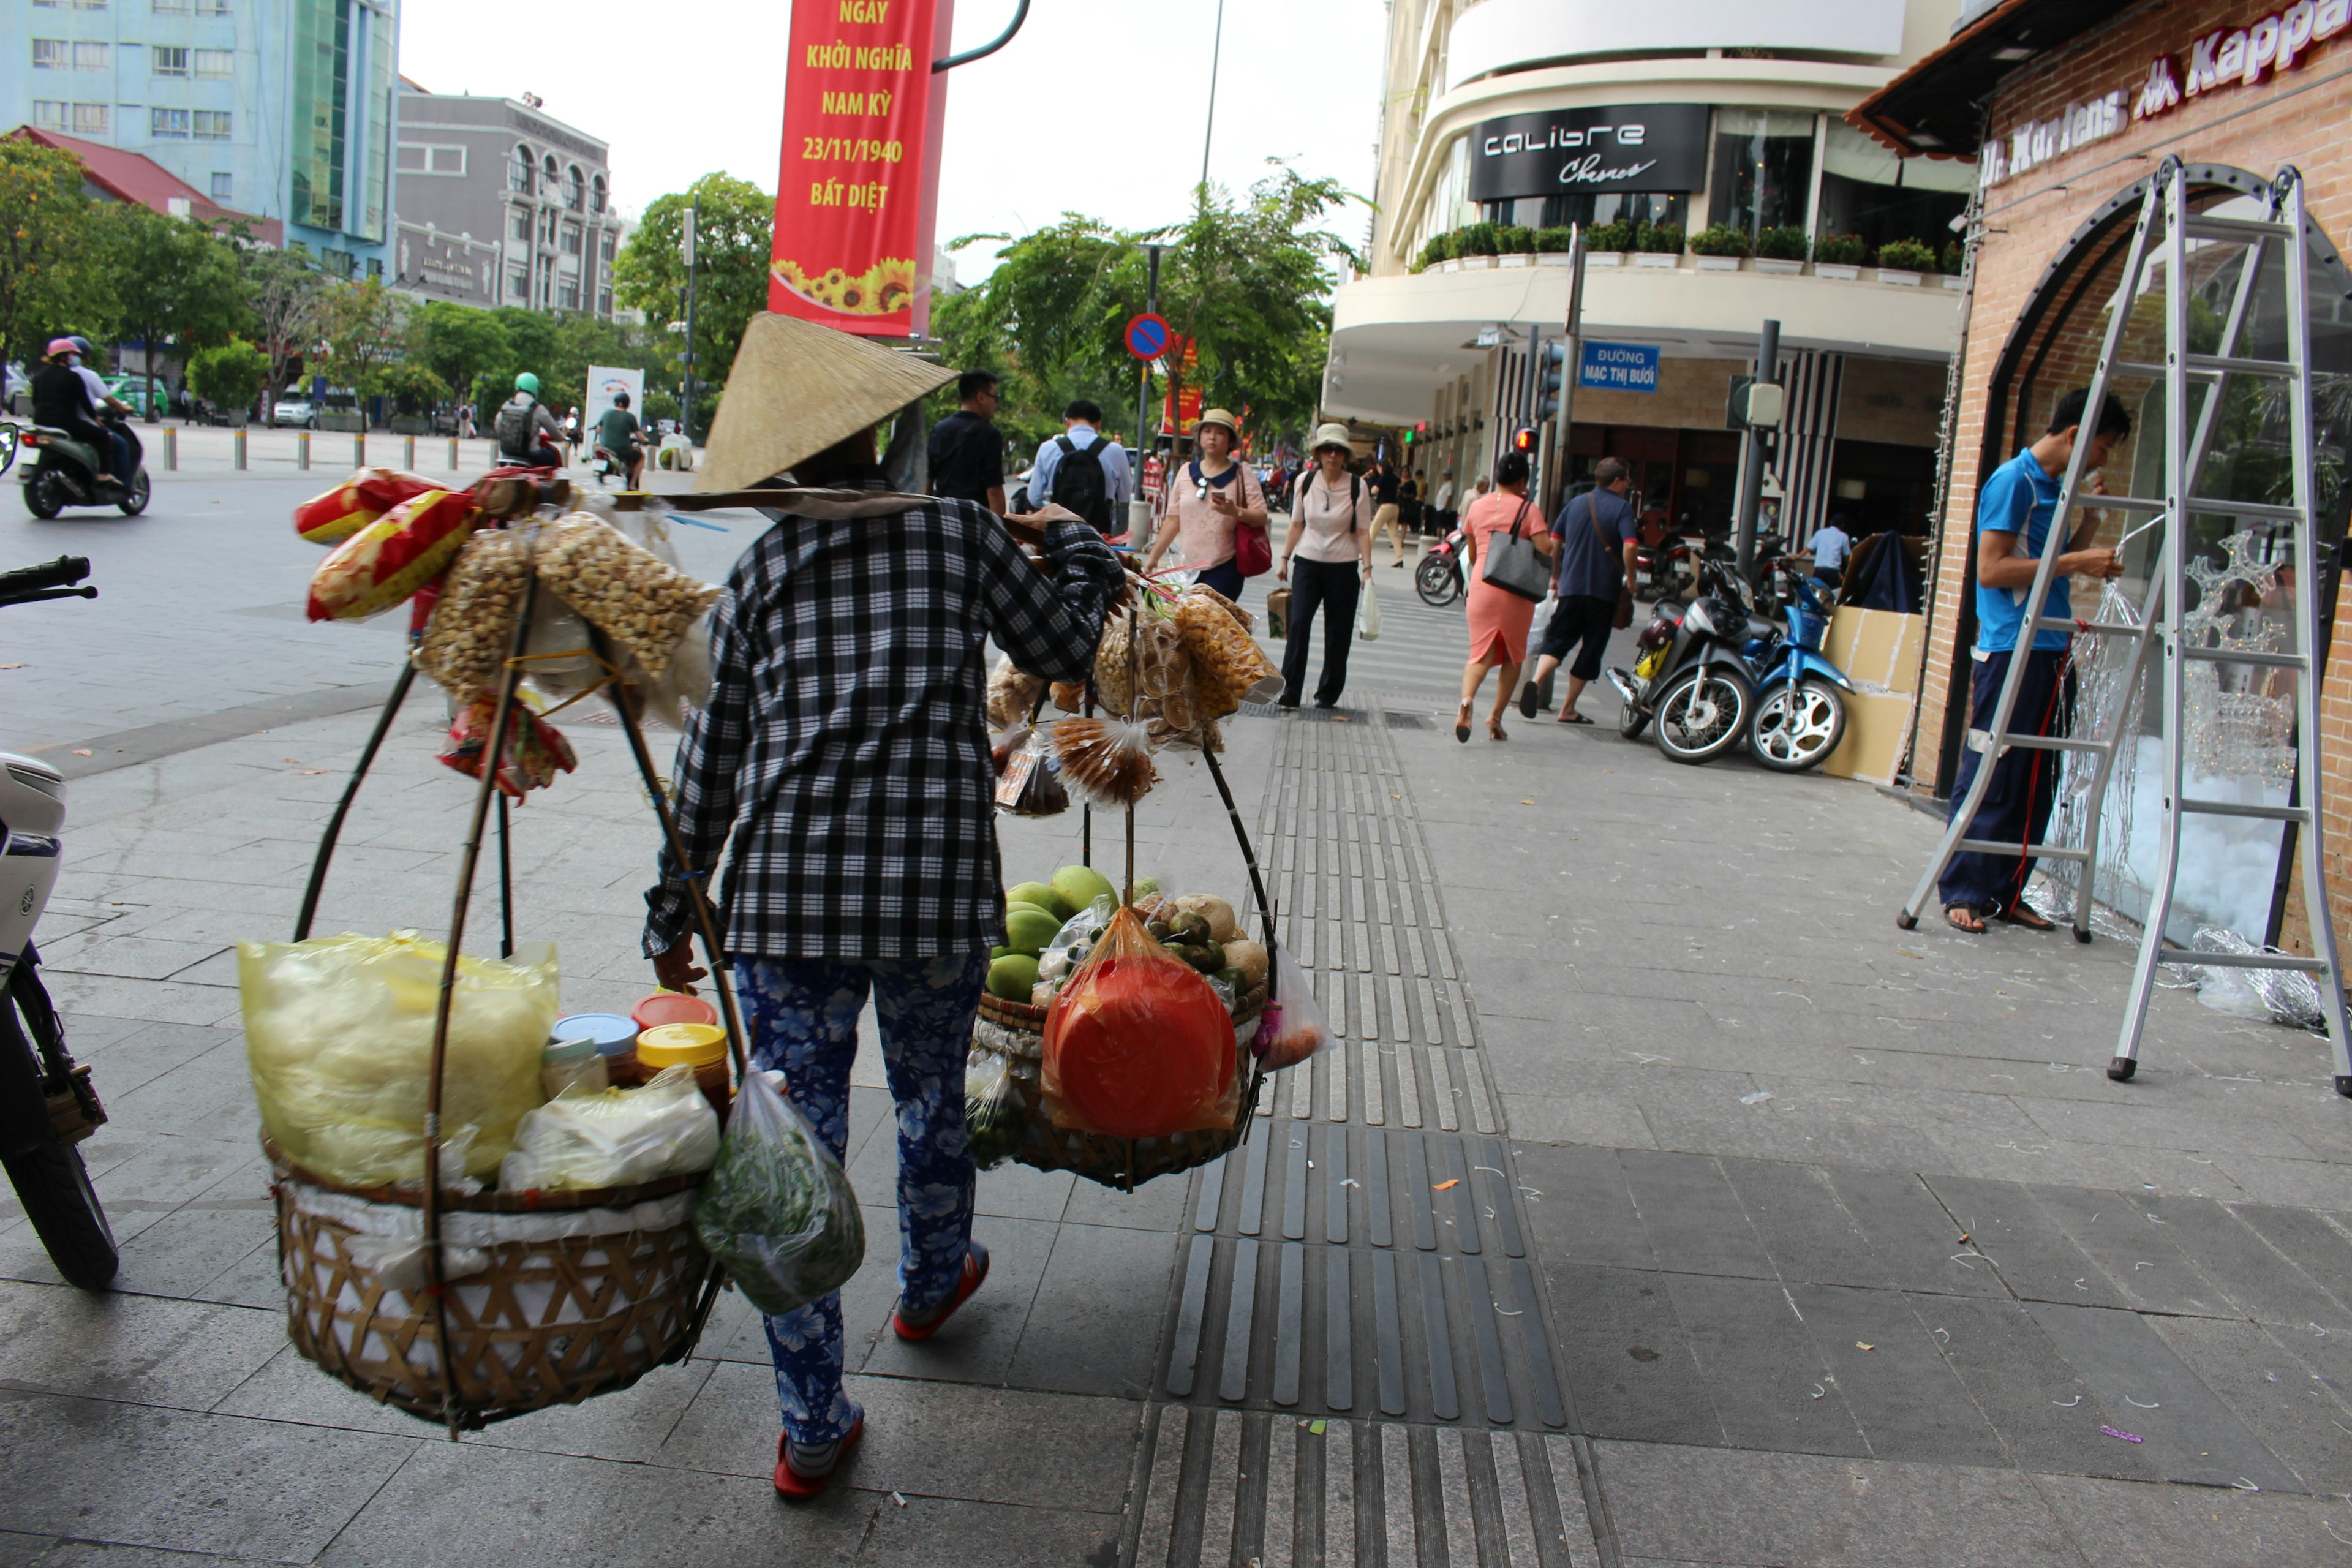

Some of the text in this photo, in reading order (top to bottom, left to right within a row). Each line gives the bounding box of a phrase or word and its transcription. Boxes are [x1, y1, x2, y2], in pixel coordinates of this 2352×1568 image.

[806, 39, 913, 71] KHỞI NGHĨA
[2185, 0, 2352, 97] Kappa
[822, 89, 892, 116] NAM KỲ
[2010, 89, 2128, 176] Martens
[802, 137, 903, 163] 23/11/1940
[810, 176, 888, 214] BẤT DIỆT
[1585, 365, 1607, 383] MẠC
[1611, 367, 1627, 386] THỊ
